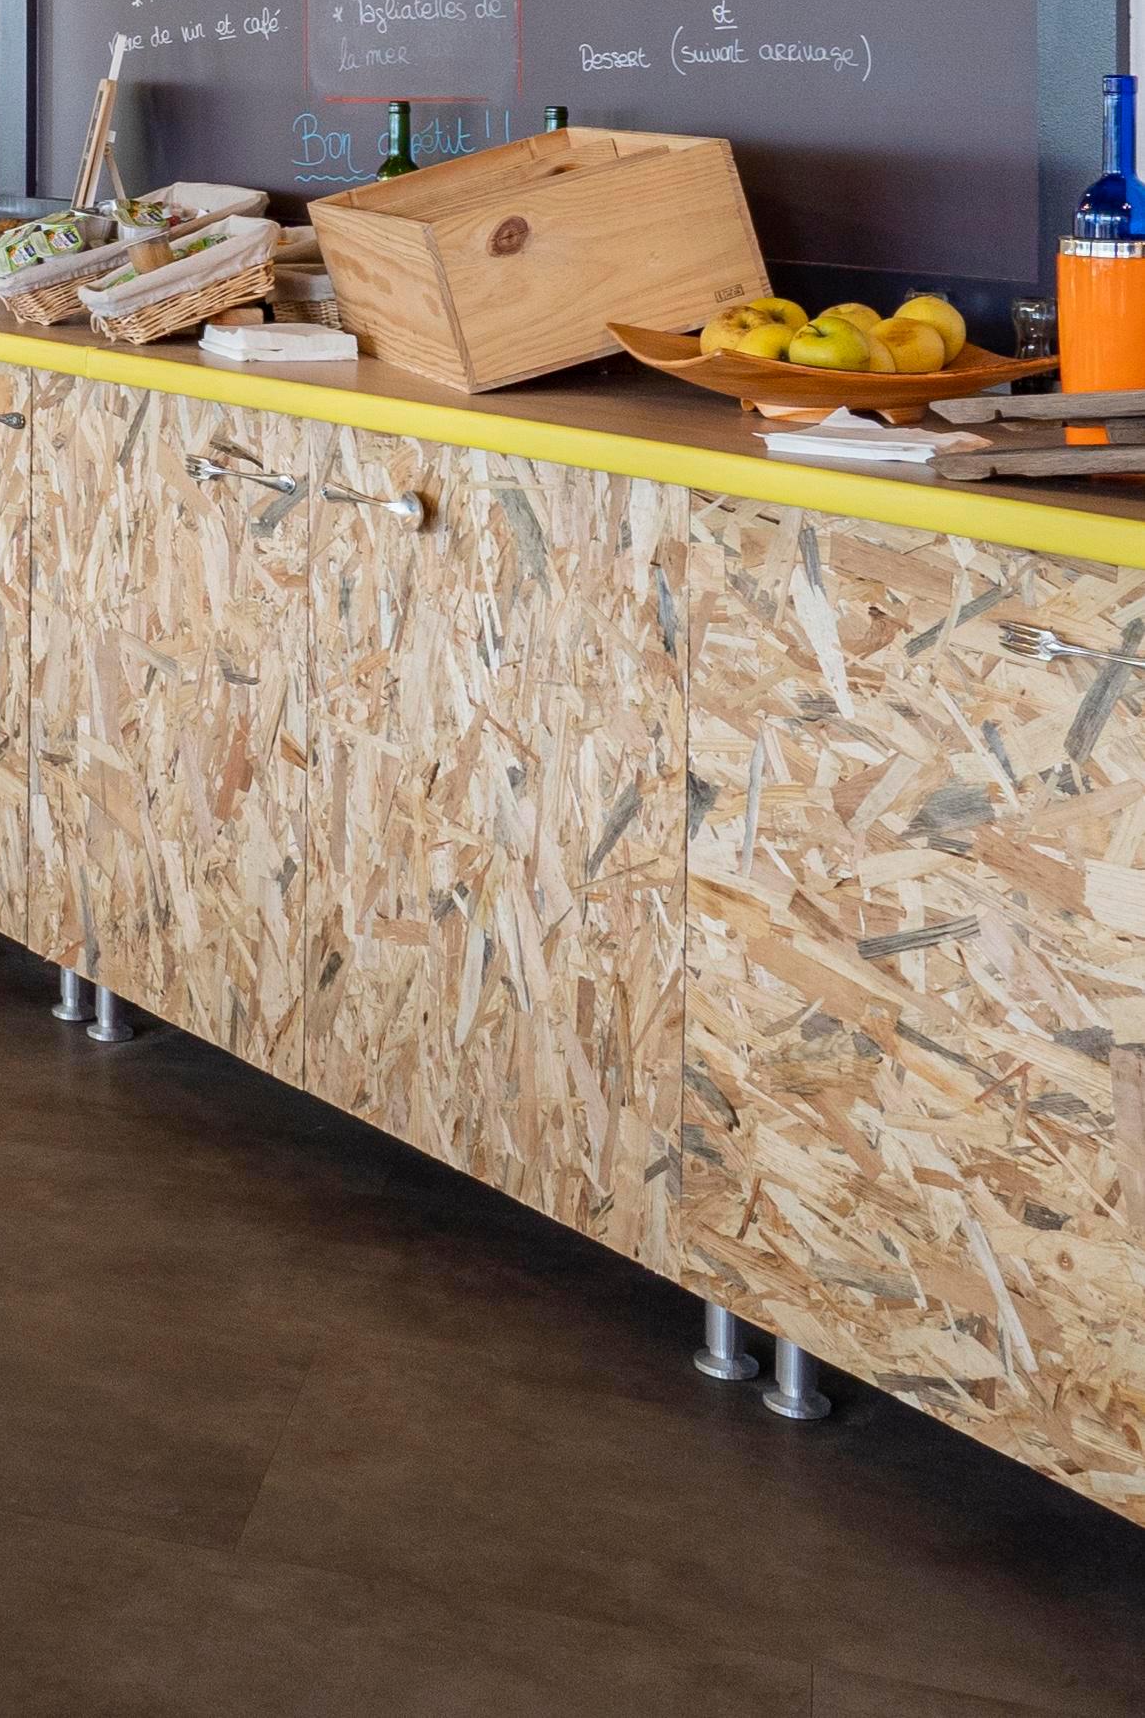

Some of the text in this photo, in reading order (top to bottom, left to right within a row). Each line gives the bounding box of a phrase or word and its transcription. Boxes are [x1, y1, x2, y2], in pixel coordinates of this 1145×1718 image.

[712, 0, 736, 25] et
[150, 25, 173, 45] de
[215, 13, 237, 36] et
[579, 43, 651, 72] Dessert
[292, 113, 363, 173] Bon
